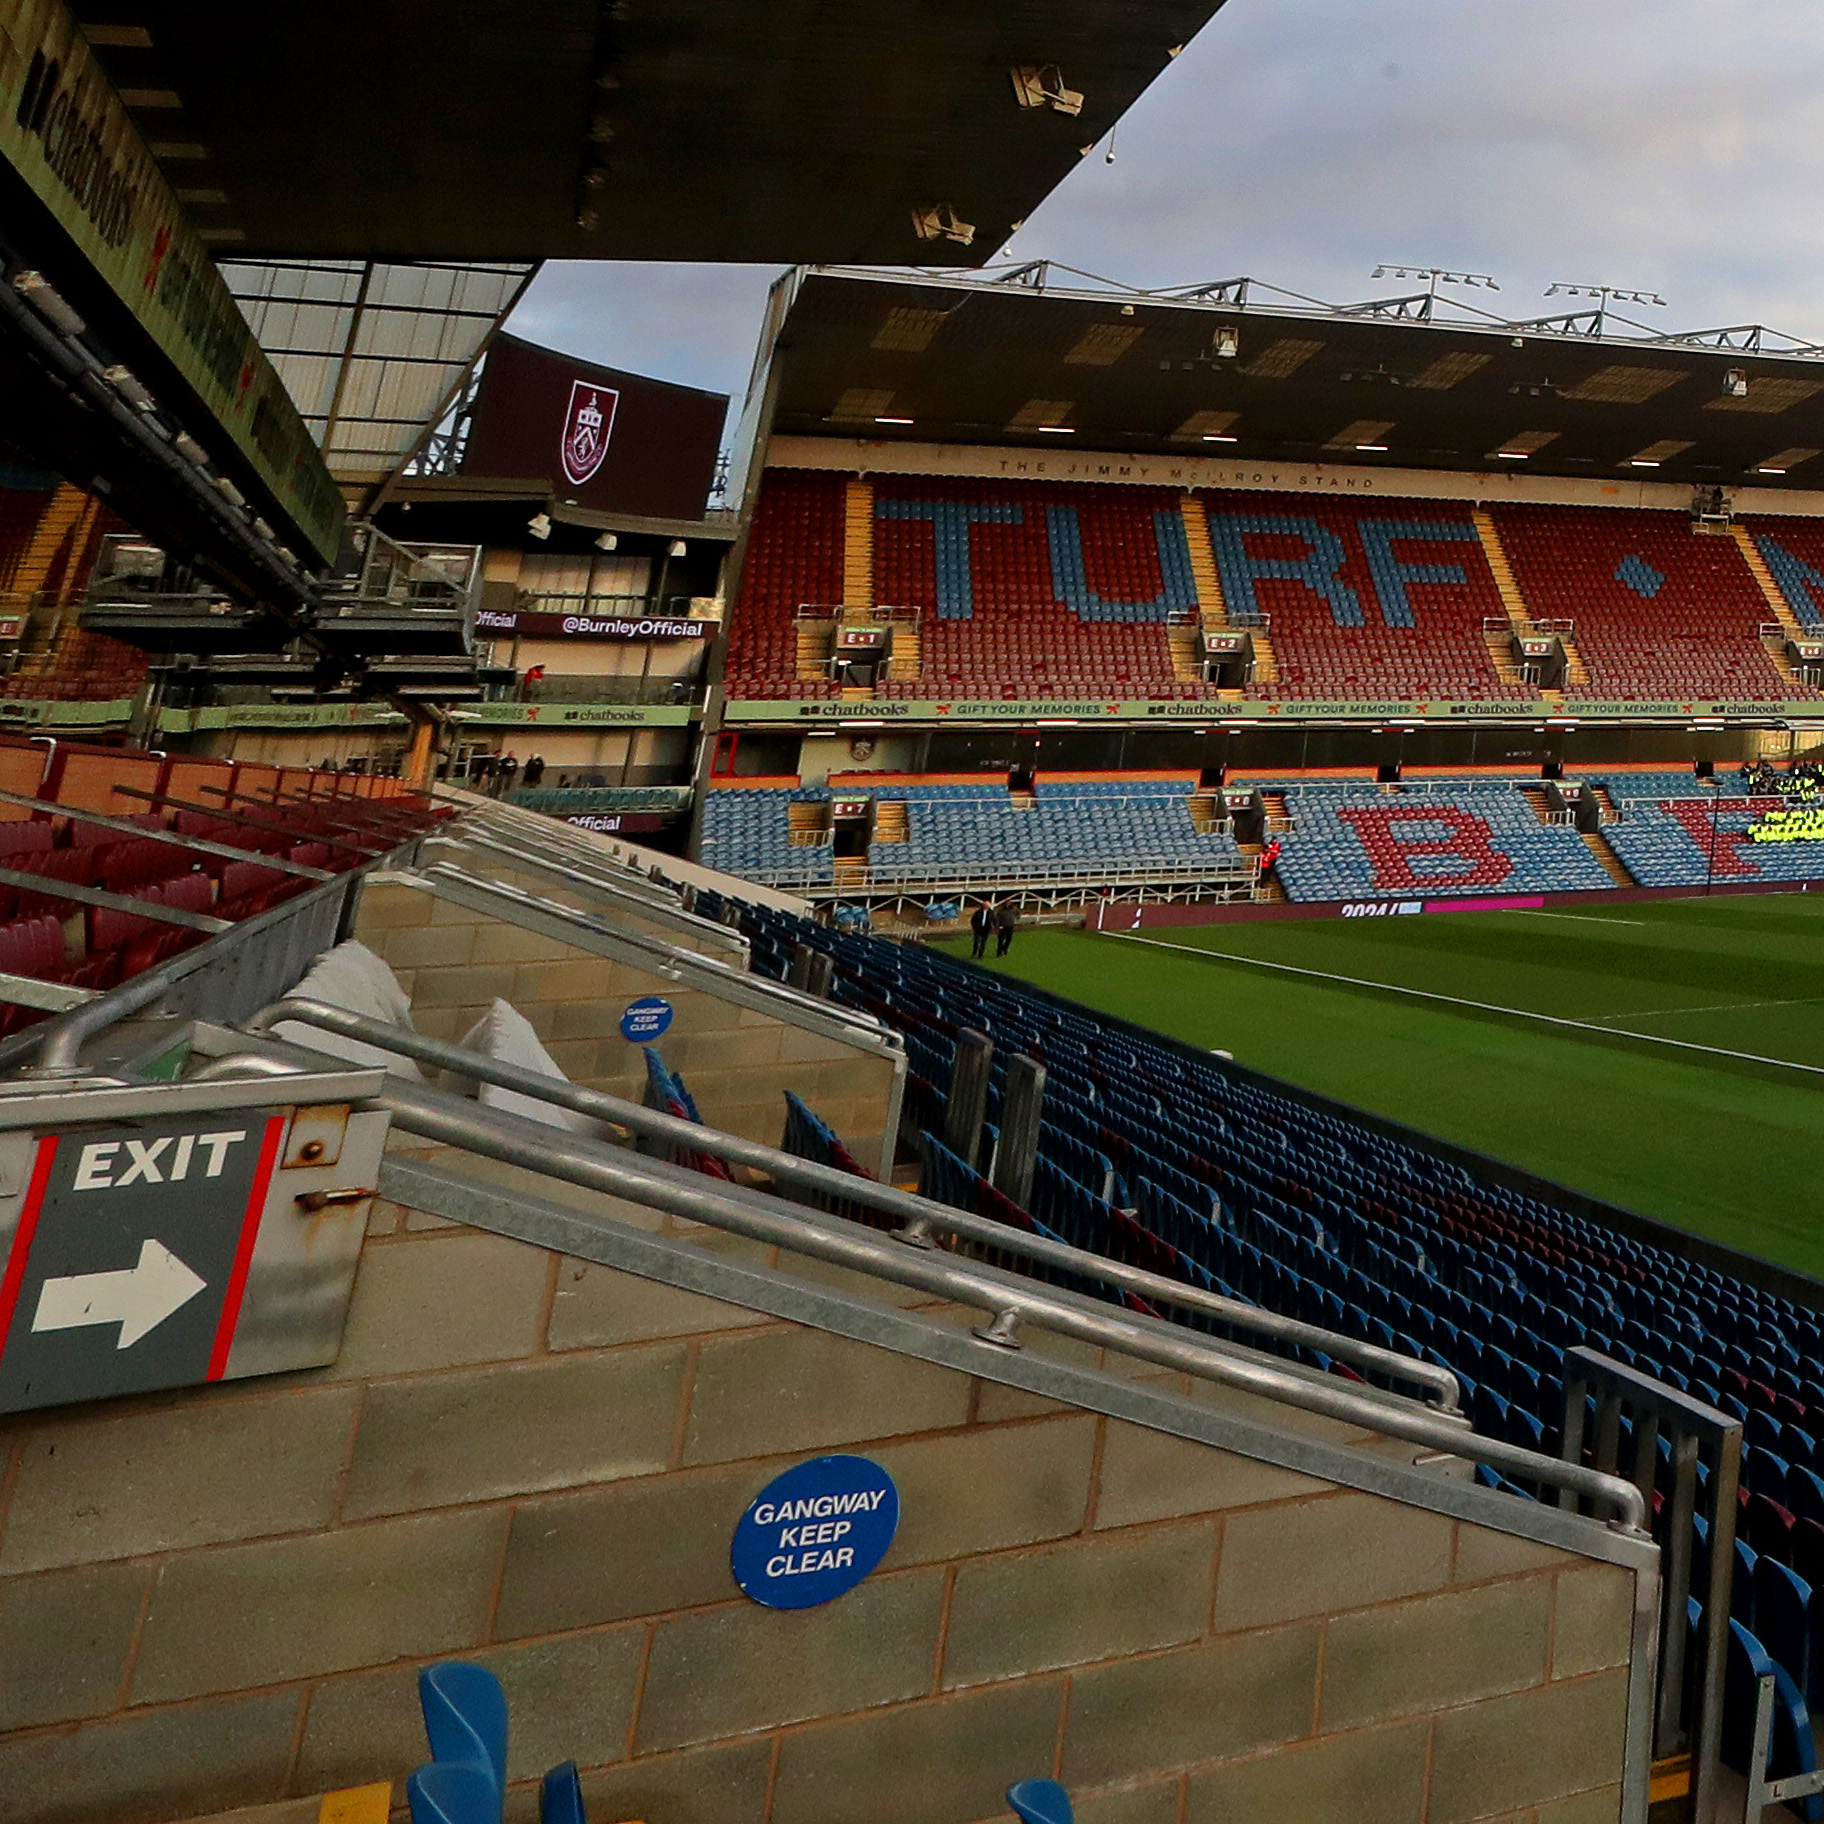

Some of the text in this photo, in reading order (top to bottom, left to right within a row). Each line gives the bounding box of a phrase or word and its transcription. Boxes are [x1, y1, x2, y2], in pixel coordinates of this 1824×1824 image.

[999, 461, 1046, 473] THE
[1067, 463, 1149, 478] JIMMY
[1299, 475, 1373, 488] STAND
[875, 499, 1479, 628] TURF
[562, 617, 703, 637] @BurnleyOfficial
[823, 704, 909, 716] chatbooks
[957, 704, 1100, 714] GIFT YOUR MEMORIES
[1167, 703, 1243, 715] chatbooks
[1286, 704, 1411, 714] GIFT YOUR MEMORIES
[1467, 703, 1534, 715] chatbooks
[1568, 704, 1678, 713] GIFT YOUR MEMORIES
[1727, 702, 1786, 714] chatbooks
[1339, 807, 1514, 890] B
[72, 1130, 247, 1191] EXIT
[753, 1489, 887, 1525] GANGWAY
[778, 1520, 852, 1549] KEEP
[765, 1546, 855, 1577] CLEAR
